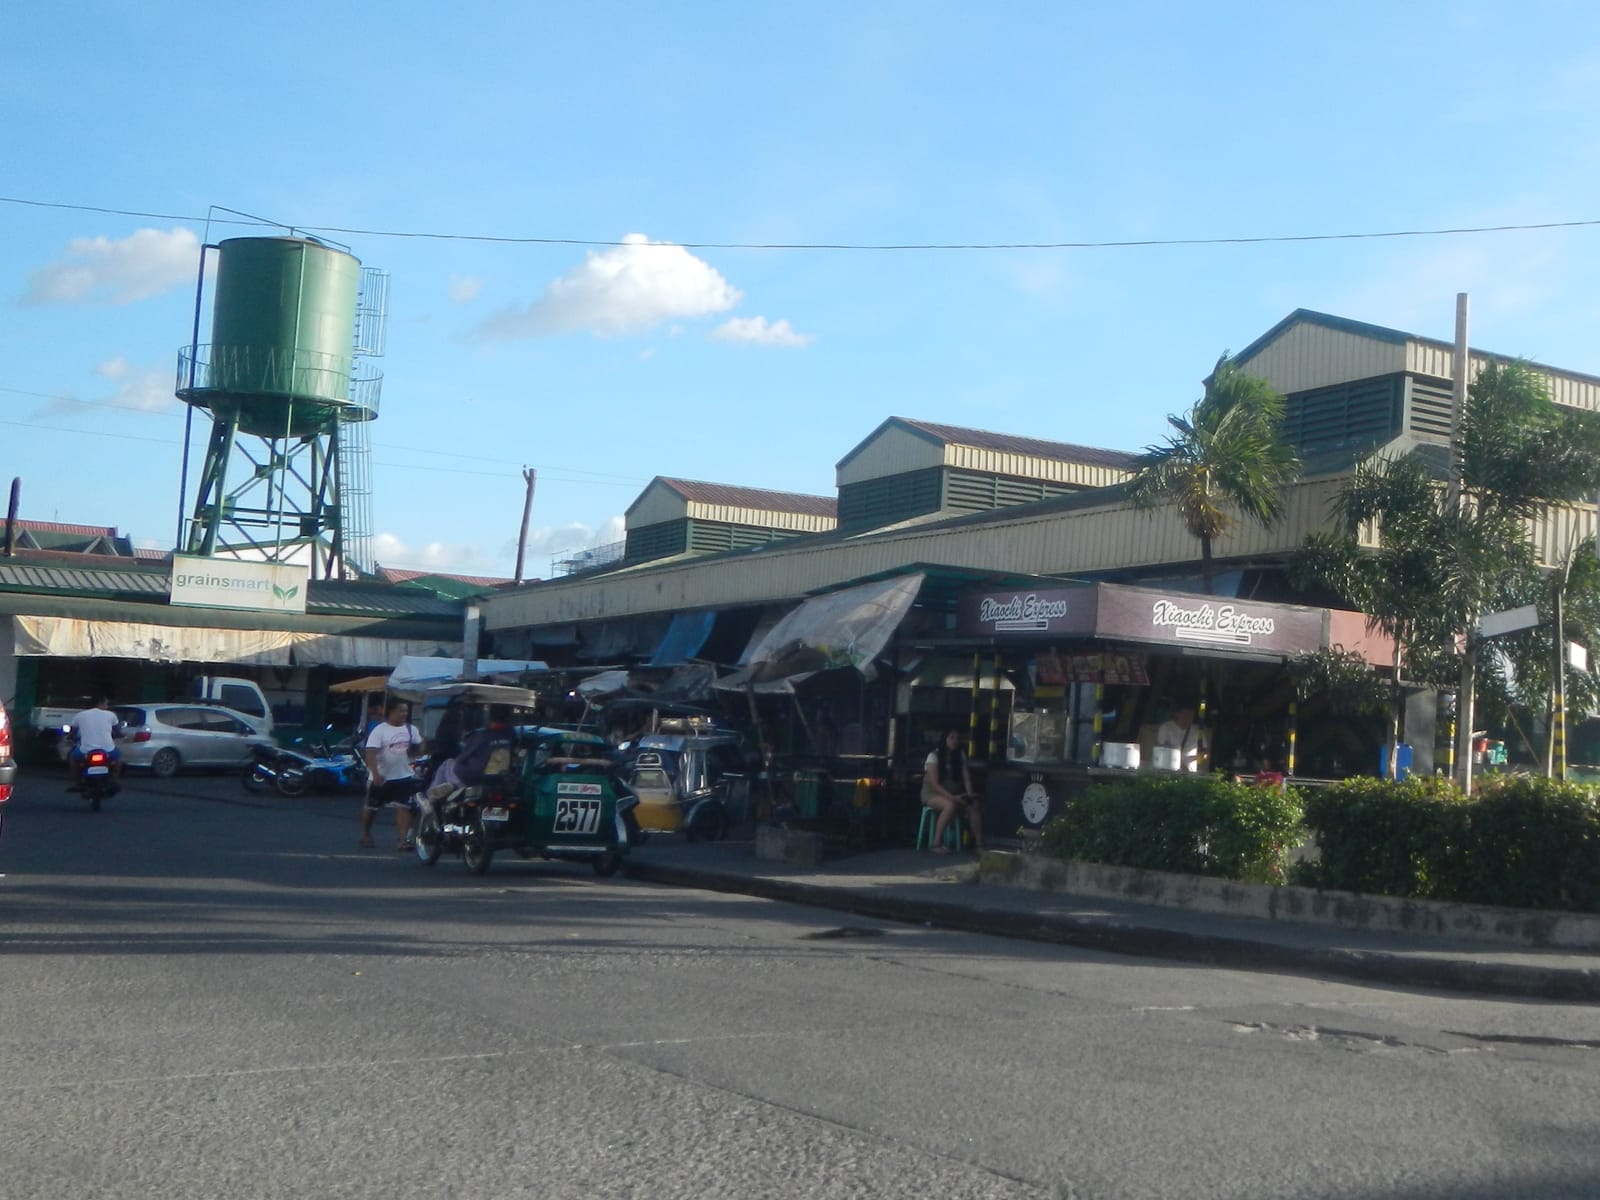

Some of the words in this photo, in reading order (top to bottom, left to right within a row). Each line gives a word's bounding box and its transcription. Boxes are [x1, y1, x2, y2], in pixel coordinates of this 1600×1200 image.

[176, 573, 270, 590] grainsmart
[980, 595, 1021, 621] Xiaochi
[1022, 593, 1067, 620] Express
[1153, 600, 1214, 627] Xiaochi
[1216, 606, 1275, 634] Express
[555, 800, 600, 831] 2577
